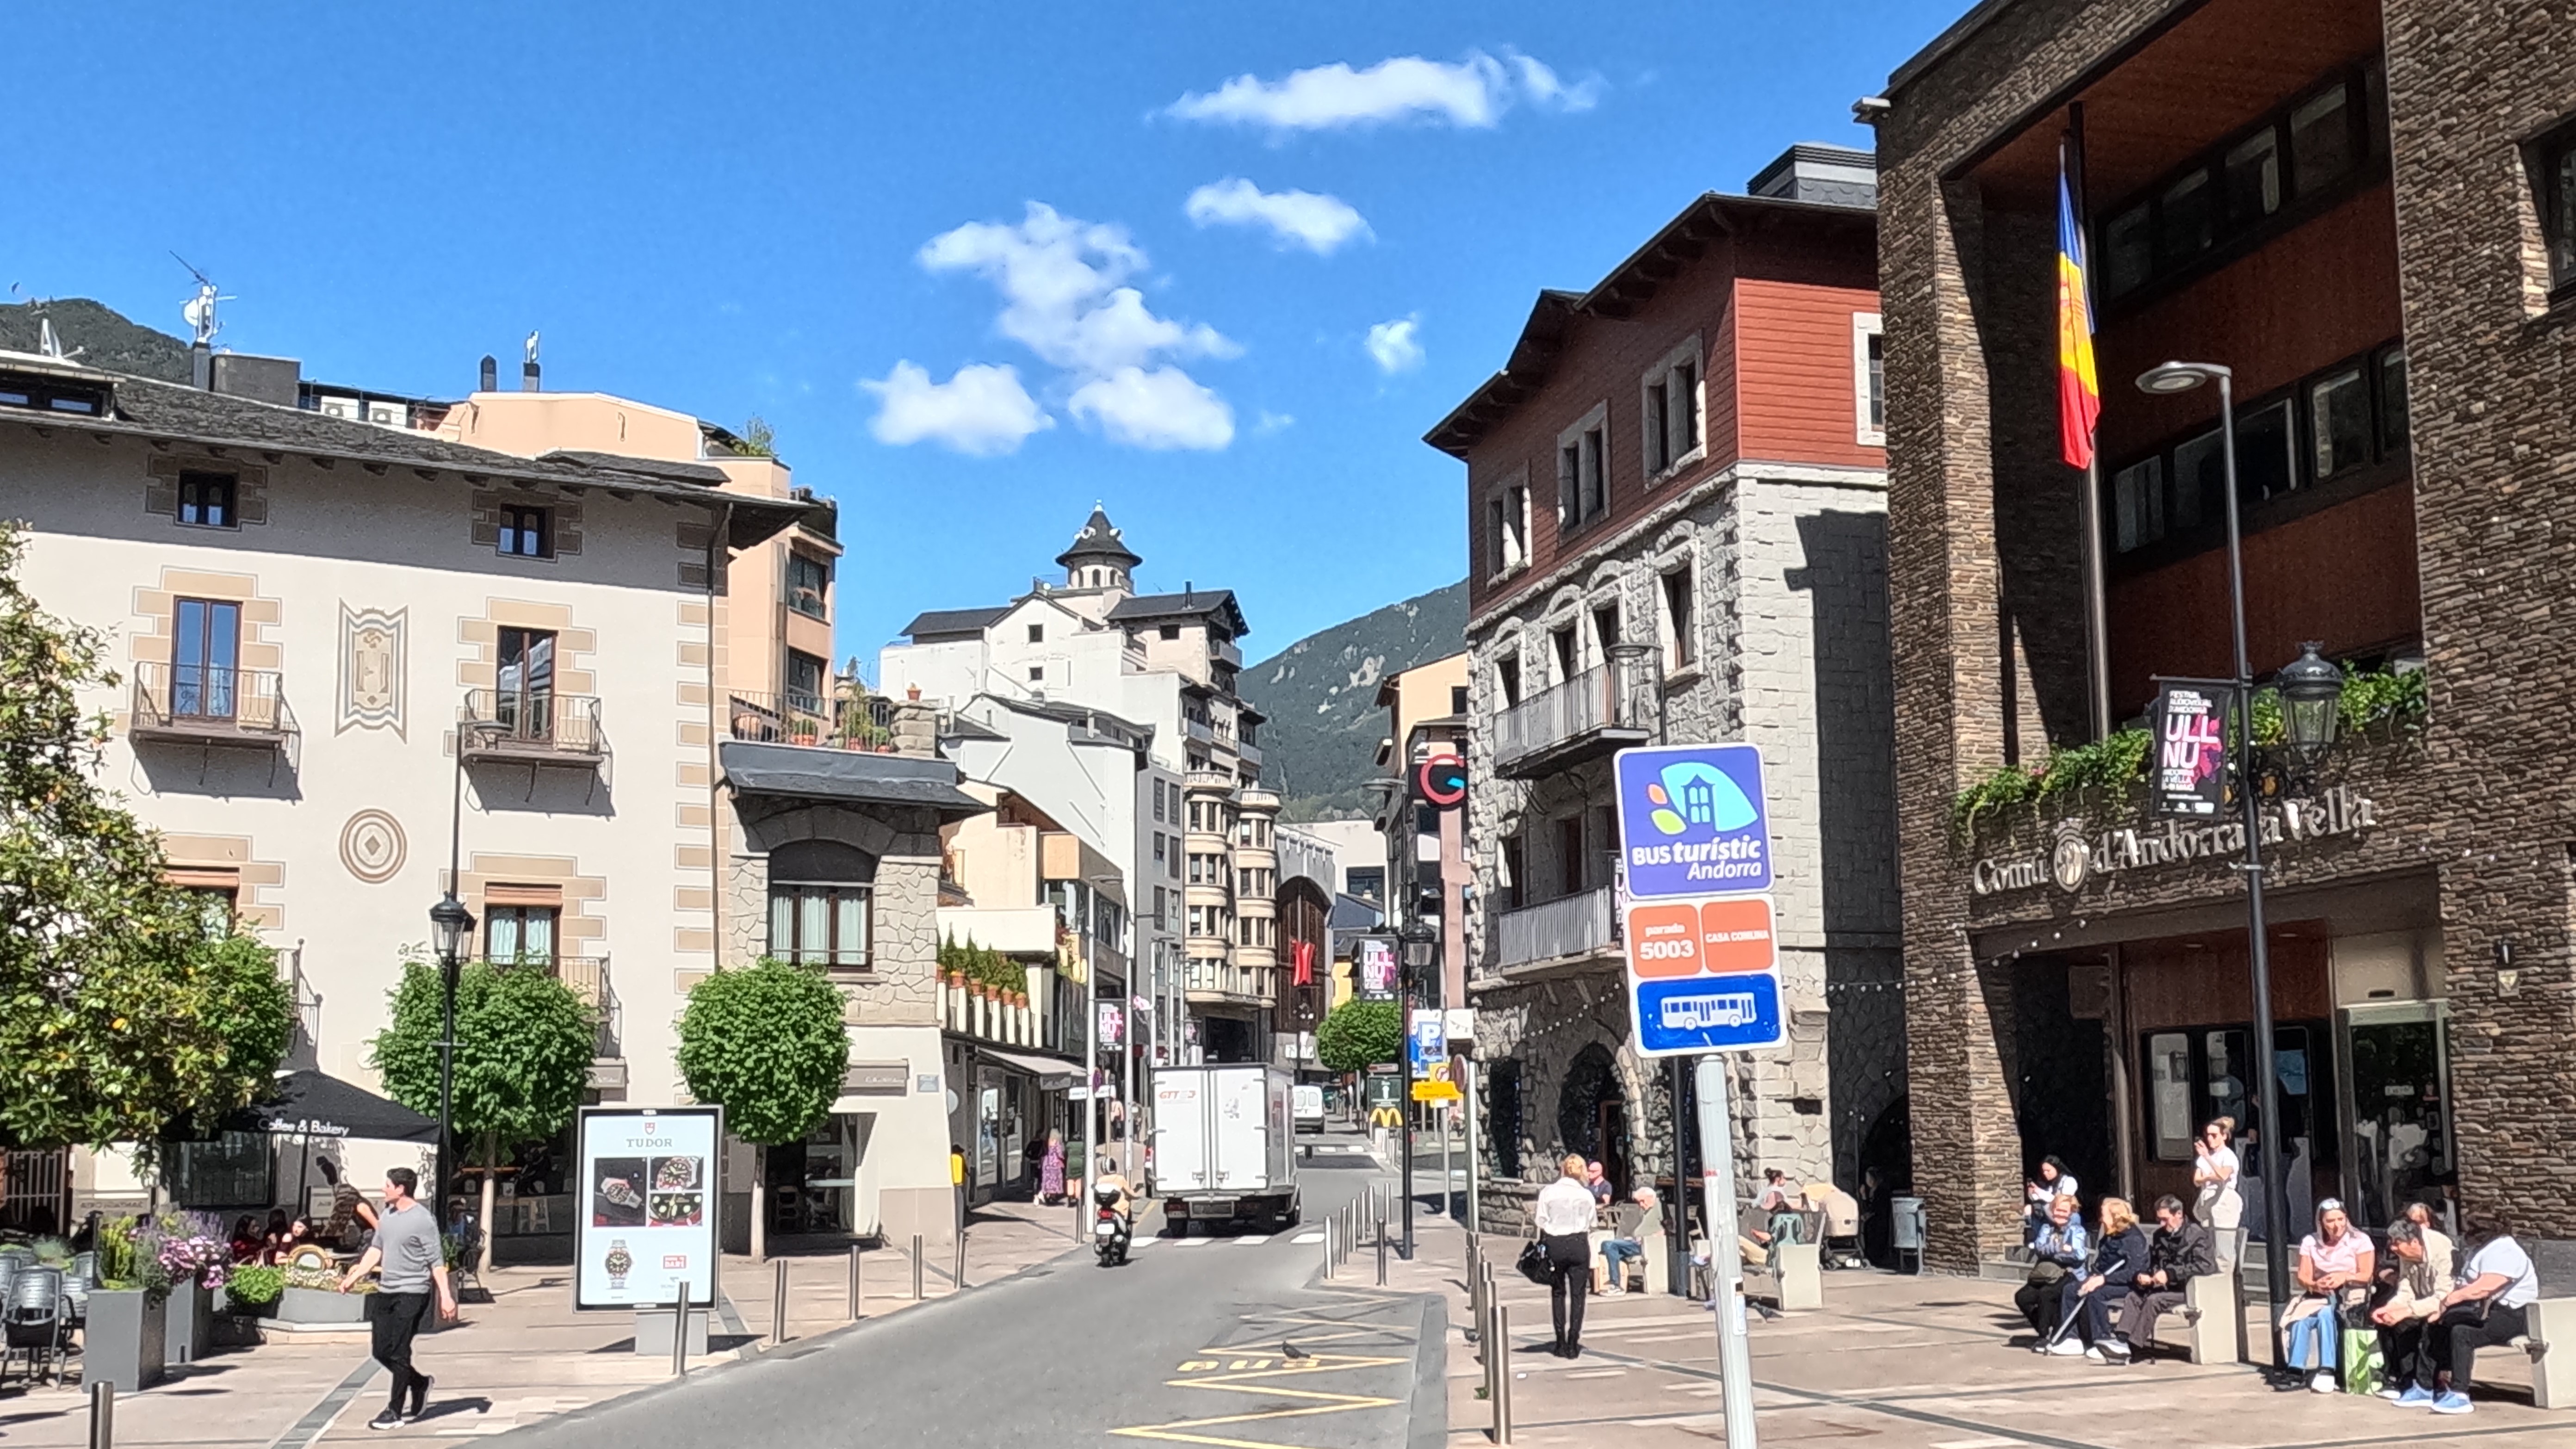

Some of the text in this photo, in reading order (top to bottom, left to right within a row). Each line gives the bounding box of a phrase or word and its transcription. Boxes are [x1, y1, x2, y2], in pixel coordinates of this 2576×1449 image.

[2166, 714, 2219, 743] ULL
[2163, 741, 2199, 769] NU
[2094, 818, 2246, 874] d'Andorra
[2282, 784, 2377, 842] Vella
[1632, 845, 1671, 866] BUS
[1672, 835, 1761, 863] turístic
[1687, 861, 1762, 880] Andorra
[1645, 923, 1685, 938] parada
[1705, 932, 1730, 943] CASA
[1640, 939, 1695, 960] 5003
[1363, 952, 1394, 966] ULL
[1363, 966, 1385, 979] NU
[1099, 1012, 1123, 1024] ULL
[1099, 1023, 1116, 1034] NU
[258, 1118, 350, 1137] Coffee & Bakery
[626, 1138, 672, 1147] TUDOR
[1177, 1359, 1321, 1372] BUS
